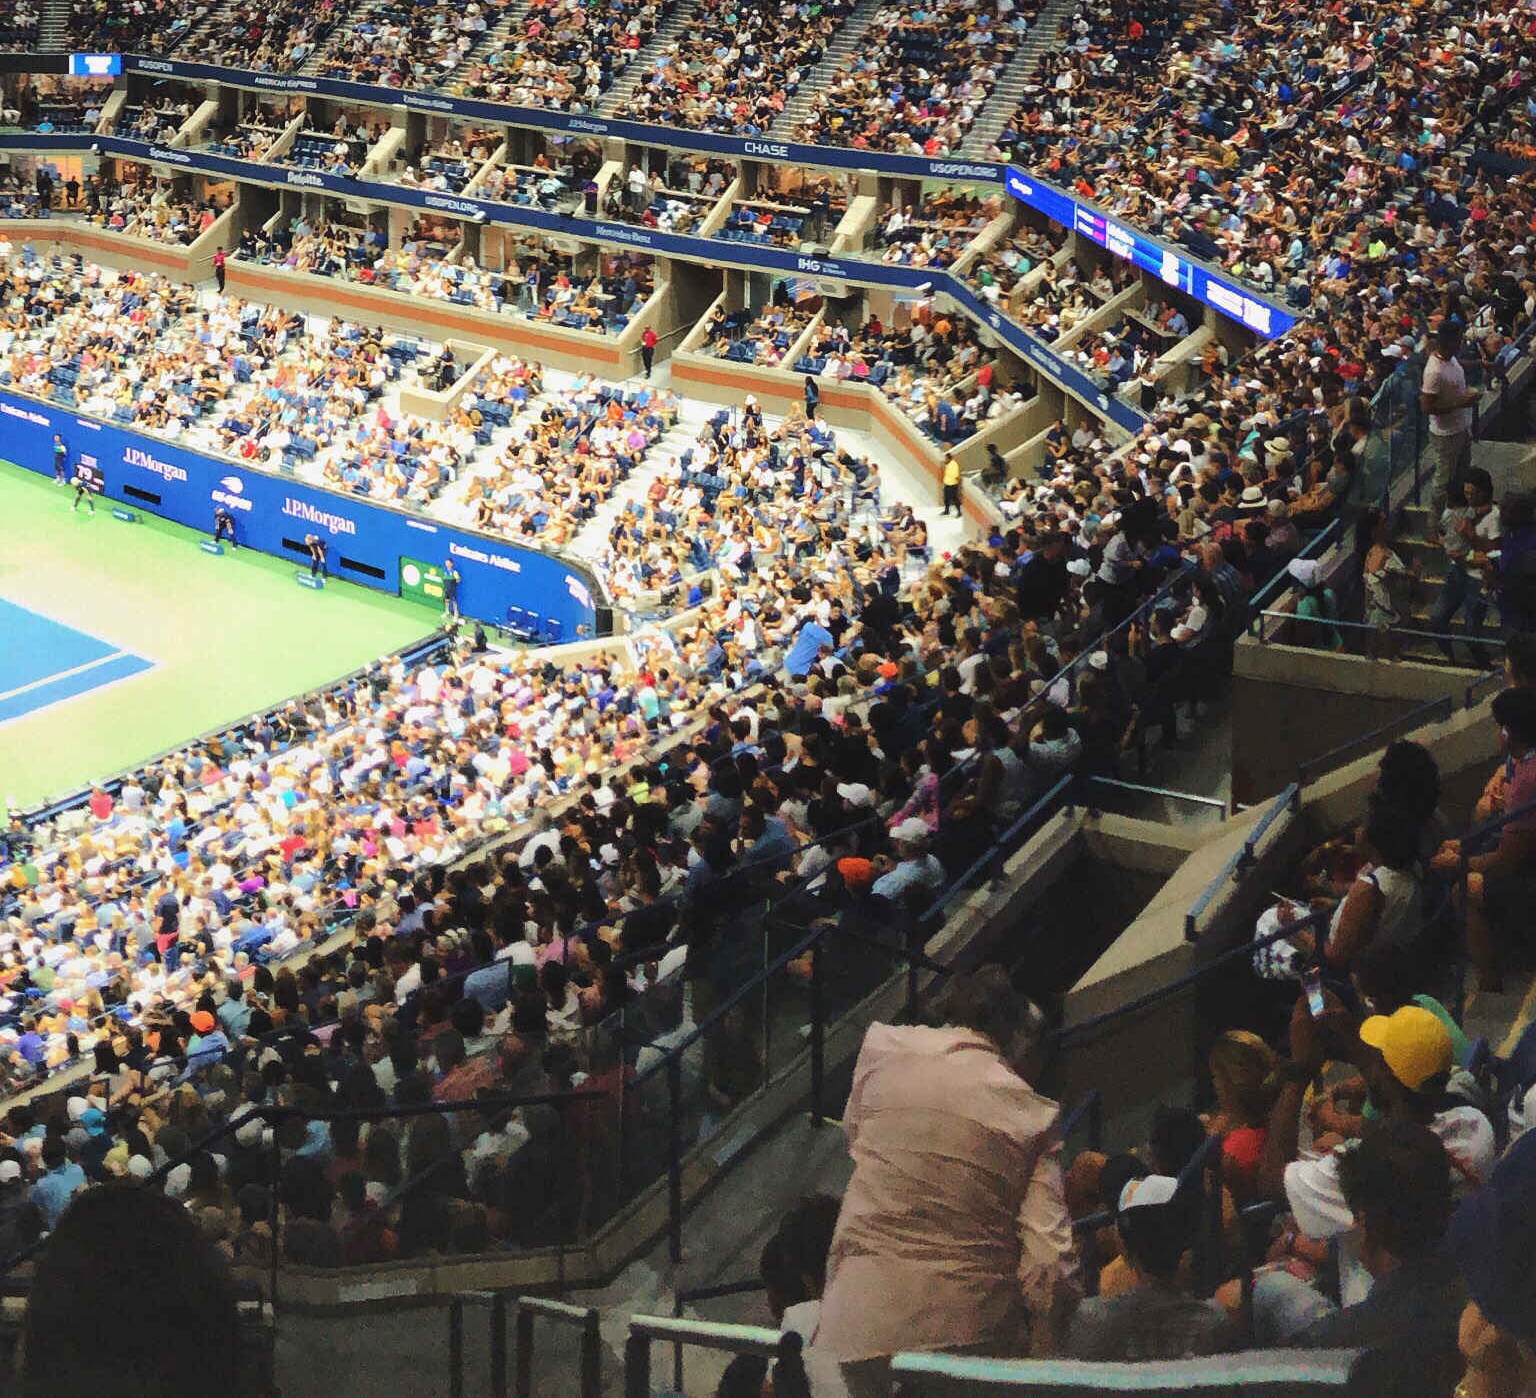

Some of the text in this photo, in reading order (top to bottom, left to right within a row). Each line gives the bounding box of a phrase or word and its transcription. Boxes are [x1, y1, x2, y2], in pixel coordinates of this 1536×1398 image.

[254, 76, 317, 89] AMERICAN EXPRESS
[744, 142, 788, 157] CHASE
[929, 162, 997, 179] USOPEN.ORG
[798, 258, 820, 271] IHG
[77, 465, 93, 480] 79
[123, 447, 188, 482] J.P.Morgan
[282, 497, 356, 534] J.P.Morgan
[449, 542, 489, 564] Emirates
